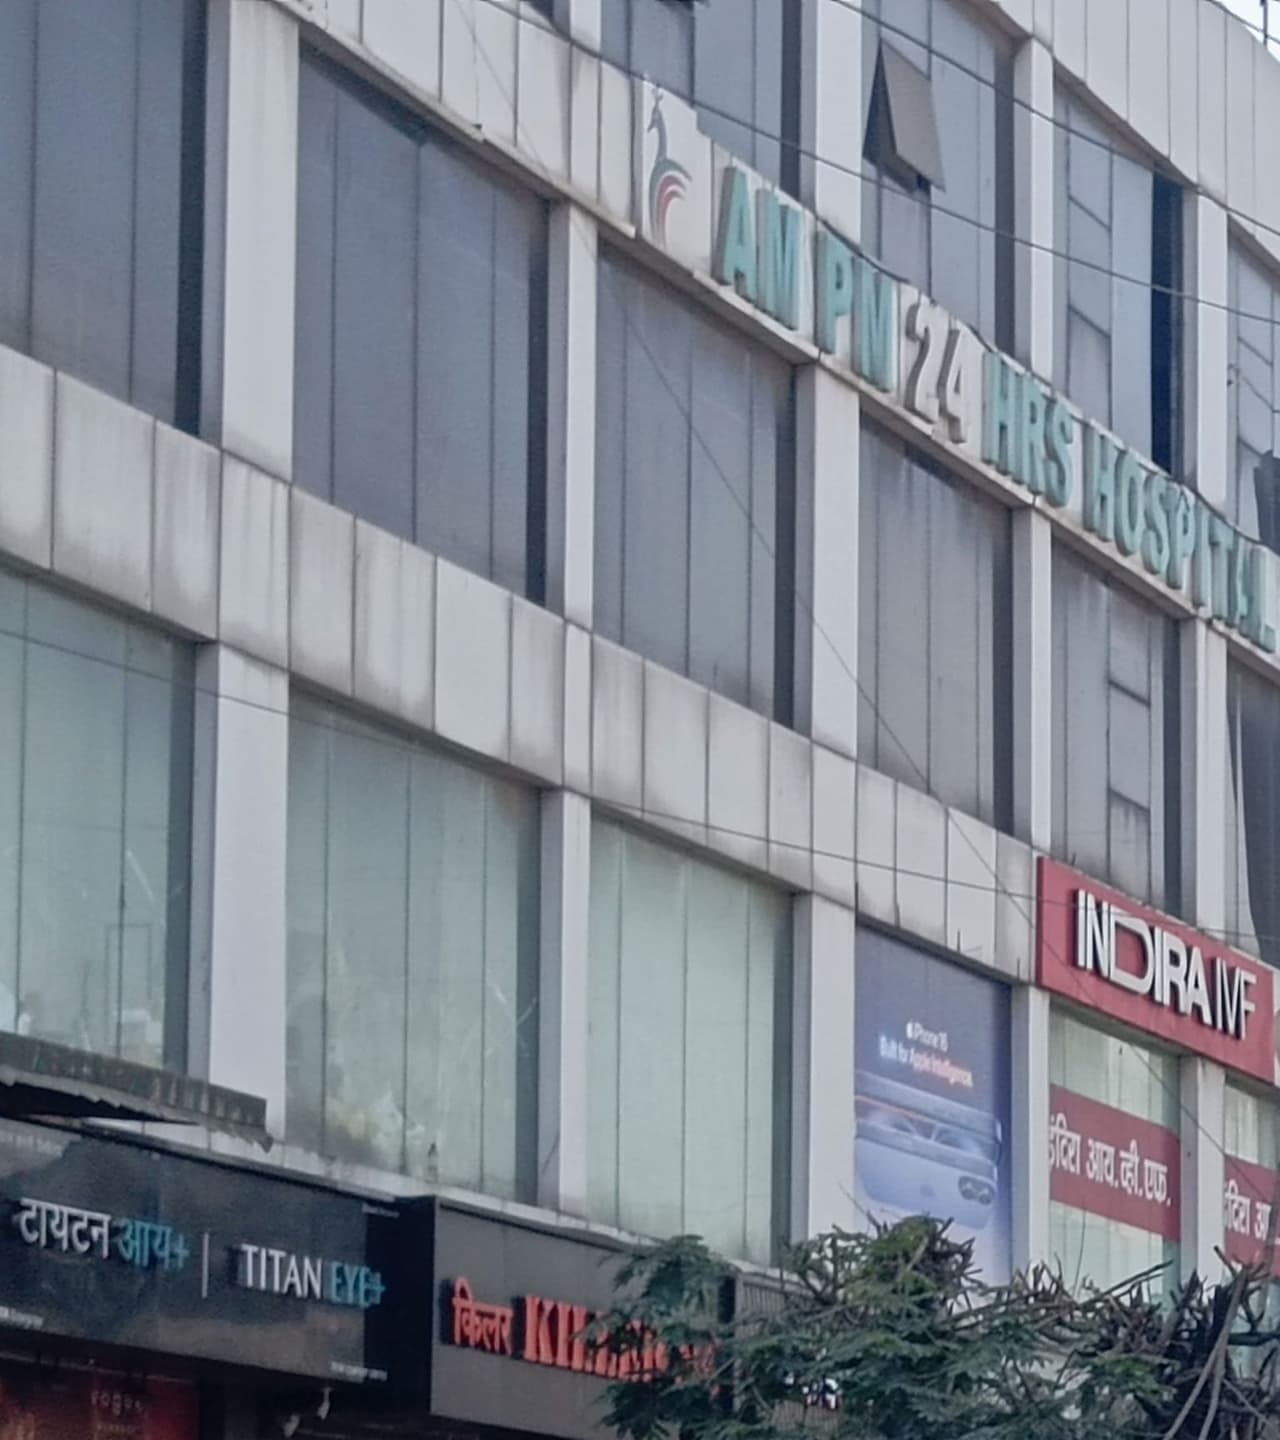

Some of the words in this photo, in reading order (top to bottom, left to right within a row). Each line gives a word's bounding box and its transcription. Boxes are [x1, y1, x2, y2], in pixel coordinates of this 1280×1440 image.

[715, 165, 810, 331] AM
[817, 227, 898, 392] PM
[906, 290, 985, 444] 24
[982, 350, 1073, 508] HRS
[1083, 425, 1276, 654] HOSPITAL
[1077, 889, 1213, 1026] INDIRA
[1215, 957, 1257, 1041] IVF
[19, 1196, 112, 1260] टायटन
[240, 1243, 323, 1300] TITAN
[452, 1276, 514, 1357] किलर
